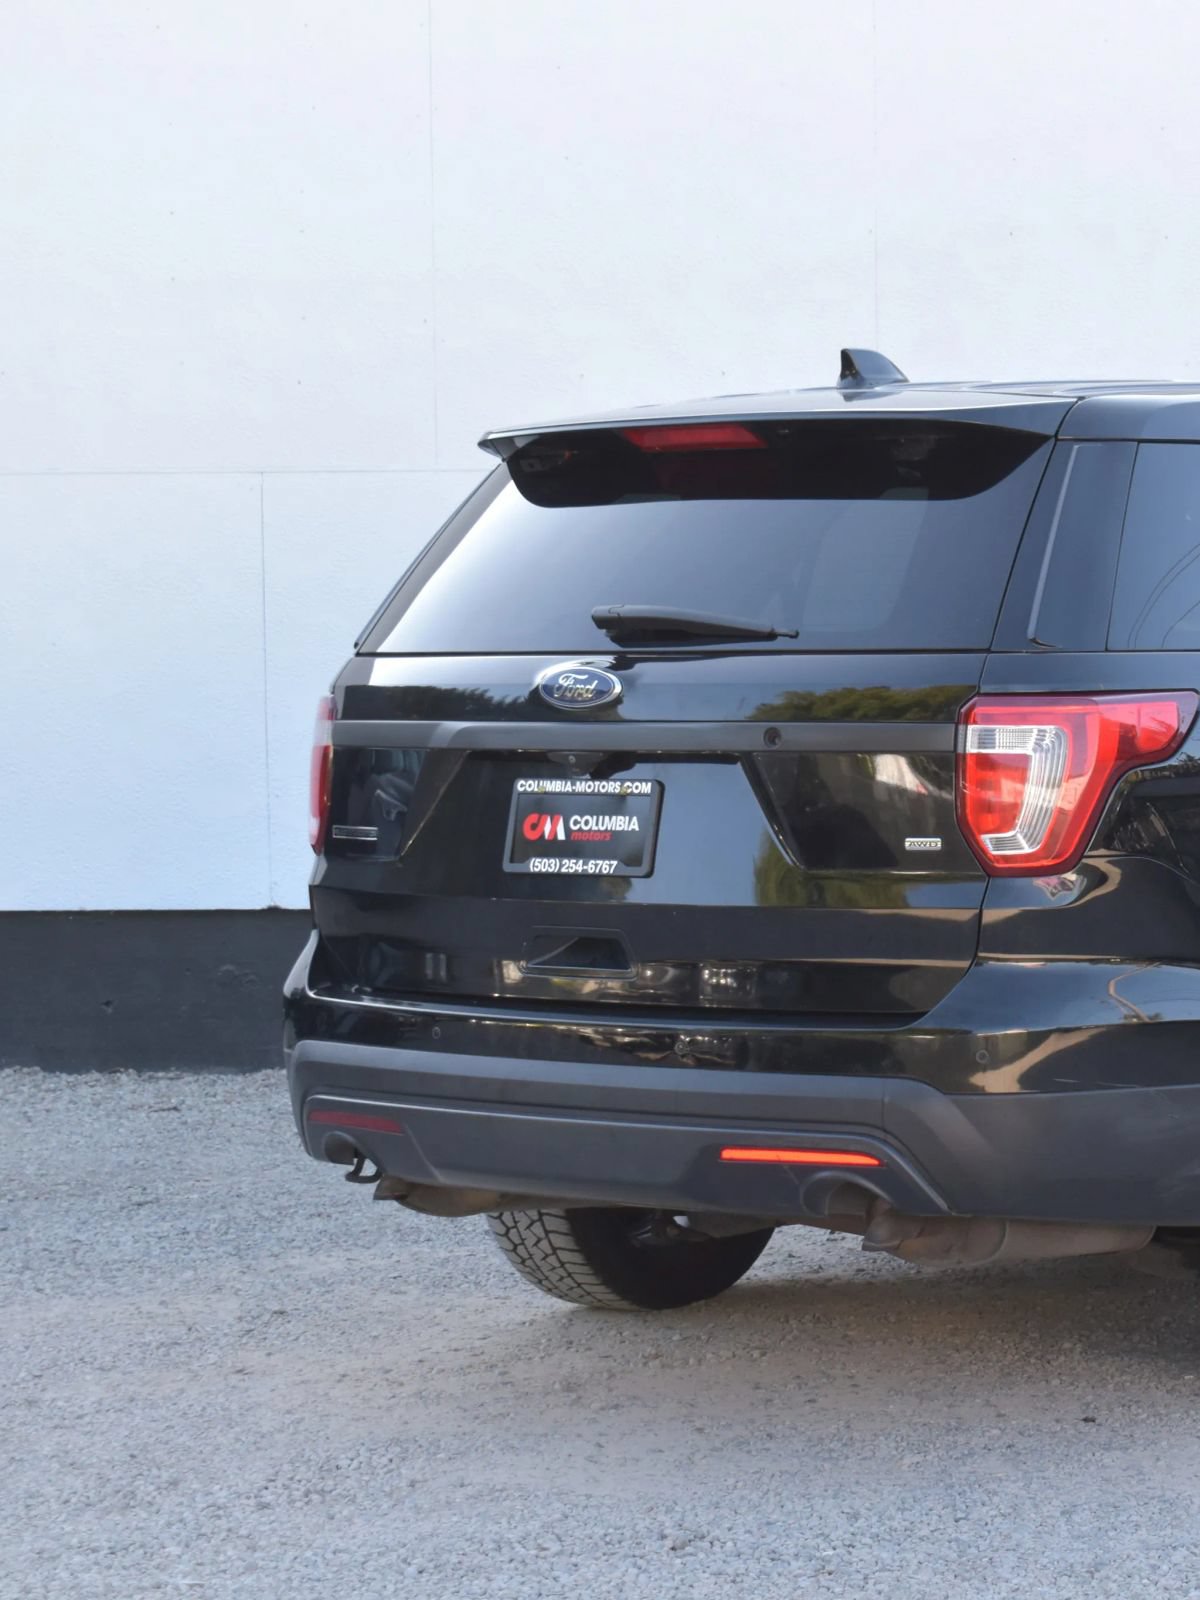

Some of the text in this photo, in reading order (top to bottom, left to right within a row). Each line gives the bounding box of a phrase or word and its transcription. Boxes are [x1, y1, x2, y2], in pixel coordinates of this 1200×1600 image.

[553, 673, 599, 698] Ford
[517, 780, 652, 794] COLUMBIA-MOTORSCOM
[569, 815, 640, 831] COLUMBIA
[570, 831, 612, 841] motors
[909, 840, 938, 849] AWD
[529, 858, 618, 873] (503) 254-6767
